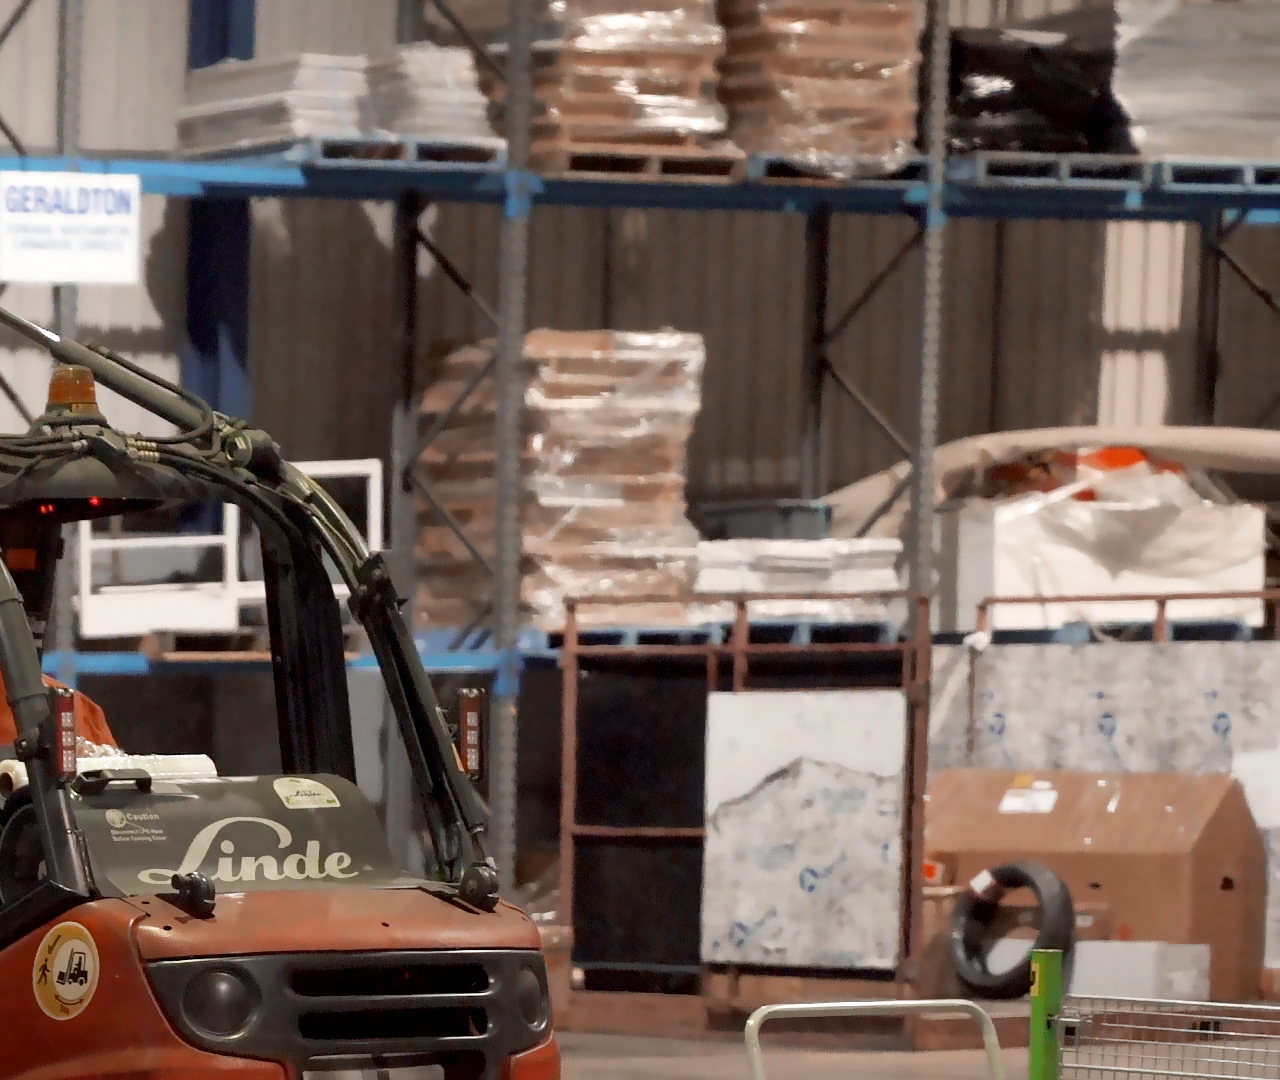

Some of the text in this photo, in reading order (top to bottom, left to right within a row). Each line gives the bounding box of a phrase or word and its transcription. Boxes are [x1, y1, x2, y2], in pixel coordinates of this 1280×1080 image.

[5, 184, 131, 216] GERALDTON
[126, 813, 159, 821] Caution
[138, 816, 359, 884] Linde
